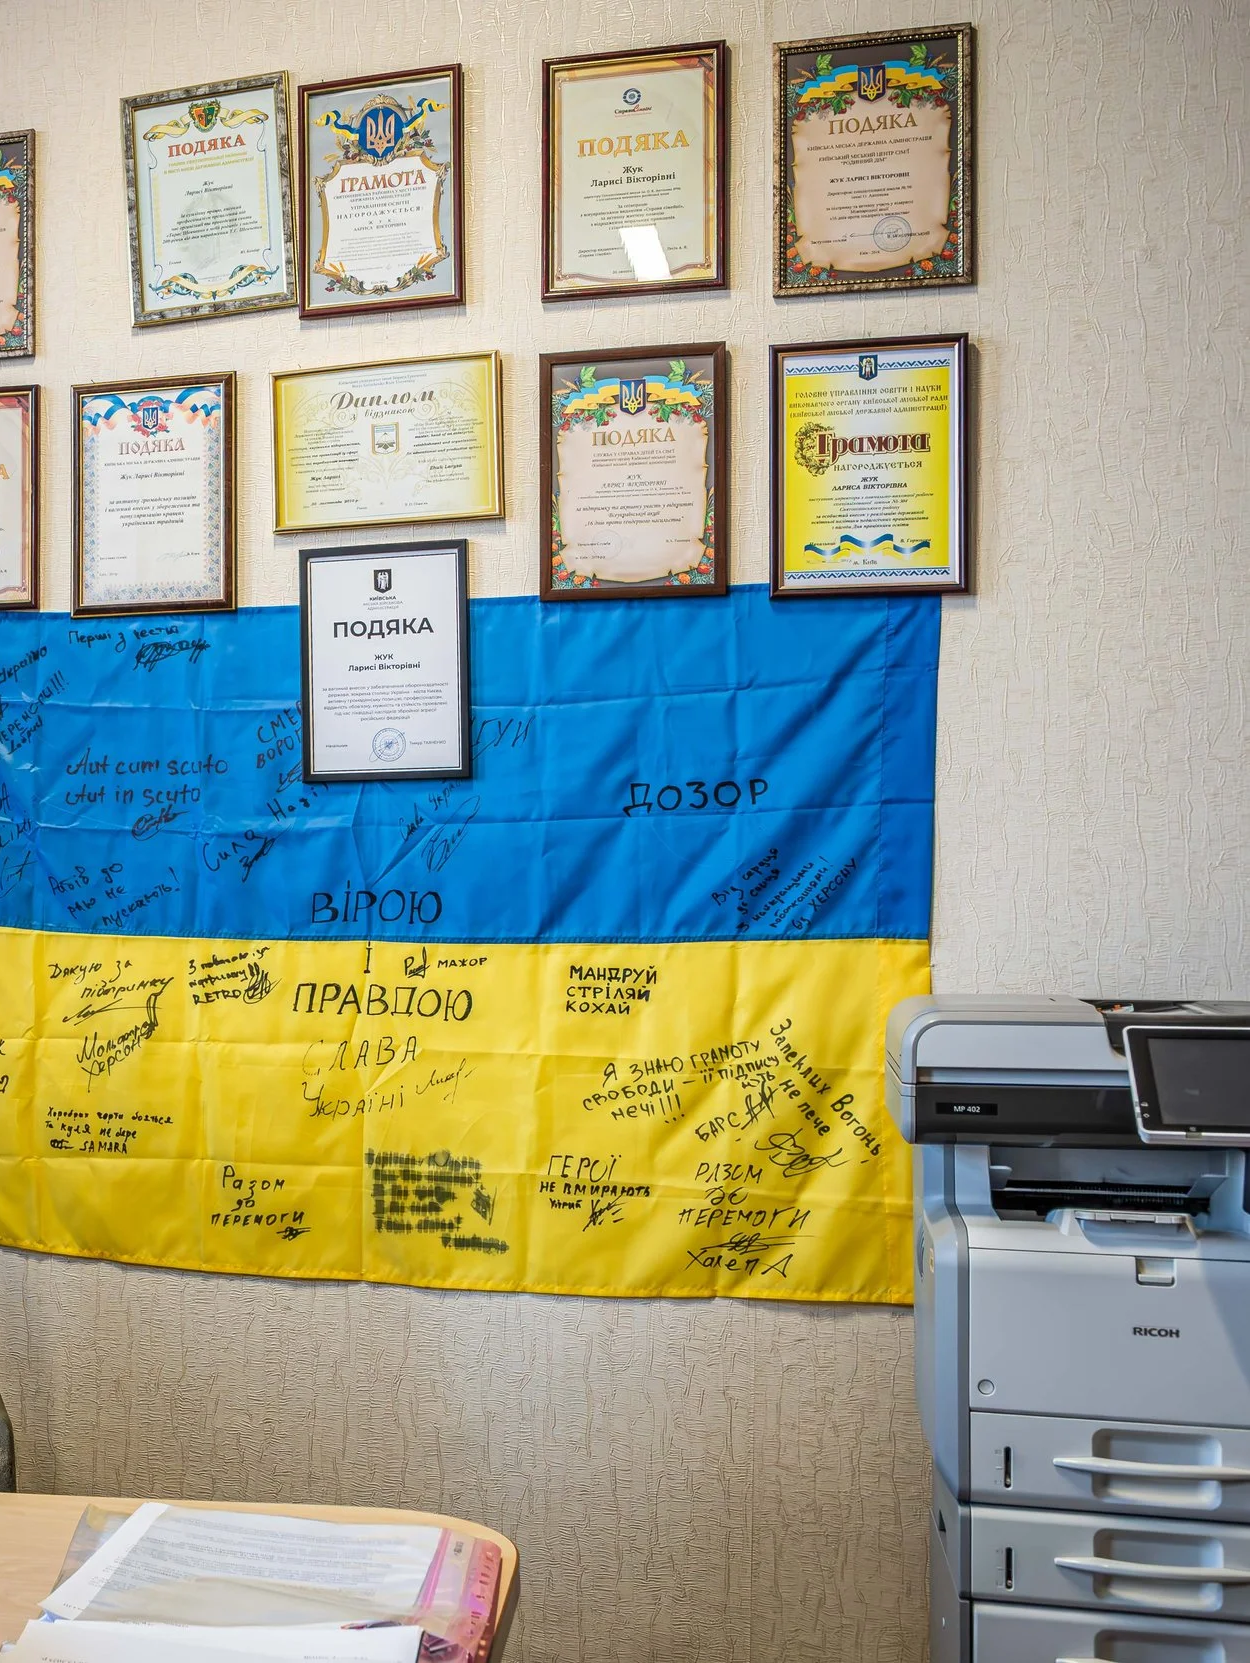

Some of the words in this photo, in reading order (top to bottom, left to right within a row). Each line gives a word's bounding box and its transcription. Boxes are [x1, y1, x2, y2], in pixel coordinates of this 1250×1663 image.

[828, 112, 918, 135] ПОДЯКА
[168, 133, 246, 158] ПОДЯКА
[577, 129, 690, 158] ПОДЯКА
[590, 176, 623, 188] Ларисі
[626, 171, 676, 184] Вікторівні
[623, 166, 644, 175] Жук
[340, 169, 427, 193] ГРАМОТА
[330, 390, 436, 410] Диплом
[795, 391, 828, 399] ГОЛОВНЕ
[830, 388, 878, 398] УПРАВЛІННЯ
[880, 386, 908, 395] ОСВІТИ
[915, 384, 942, 392] НАУКИ
[836, 399, 861, 407] ОРГАНУ
[930, 394, 949, 402] РАДИ
[365, 407, 415, 419] відзнакою
[118, 438, 185, 456] ПОДЯКА
[592, 427, 676, 447] ПОДЯКА
[816, 432, 931, 465] Грамота
[834, 460, 923, 472] НАГОРОДЖУЄТЬСЯ
[863, 482, 908, 490] ВІКТОРІВНА
[333, 617, 435, 639] ПОДЯКА
[348, 663, 377, 672] Ларисі
[378, 661, 421, 671] Вікторівні
[374, 653, 394, 661] ЖУК
[471, 715, 536, 747] ГУН
[66, 747, 108, 776] Aut
[115, 759, 159, 776] cum
[167, 755, 228, 777] scuto
[65, 786, 105, 805] Aut
[115, 785, 134, 802] in
[144, 783, 201, 807] scuto
[623, 778, 769, 818] ДОЗОР
[101, 863, 123, 884] до
[105, 885, 127, 899] не
[311, 880, 442, 924] ВІРОЮ
[48, 963, 102, 985] Дякую
[109, 960, 132, 983] за
[437, 956, 487, 969] МАЖОР
[570, 965, 658, 985] МАНДРУЙ
[292, 982, 473, 1022] ПРАВДОЮ
[566, 983, 650, 1002] СТРІЛЯЙ
[566, 1001, 631, 1016] КОХАЙ
[302, 1035, 421, 1077] СЛАВА
[602, 1062, 618, 1088] Я
[629, 1056, 684, 1083] ЗНАЮ
[689, 1040, 760, 1069] ГРАМОТУ
[582, 1078, 675, 1111] СВОБОДИ
[953, 1105, 966, 1113] MP
[967, 1105, 981, 1113] 402
[694, 1111, 741, 1143] БАРС
[831, 1093, 882, 1157] Вогонь
[79, 1140, 128, 1154] SAMARA
[548, 1154, 622, 1183] ГЕРОЇ
[222, 1164, 285, 1201] Разом
[539, 1181, 556, 1193] НЕ
[563, 1182, 651, 1198] ВМИРАЮТЬ
[210, 1211, 305, 1226] ПЕРЕМОГИ
[678, 1206, 811, 1230] ПЕРЕМОГИ
[1132, 1326, 1180, 1339] RICOH
